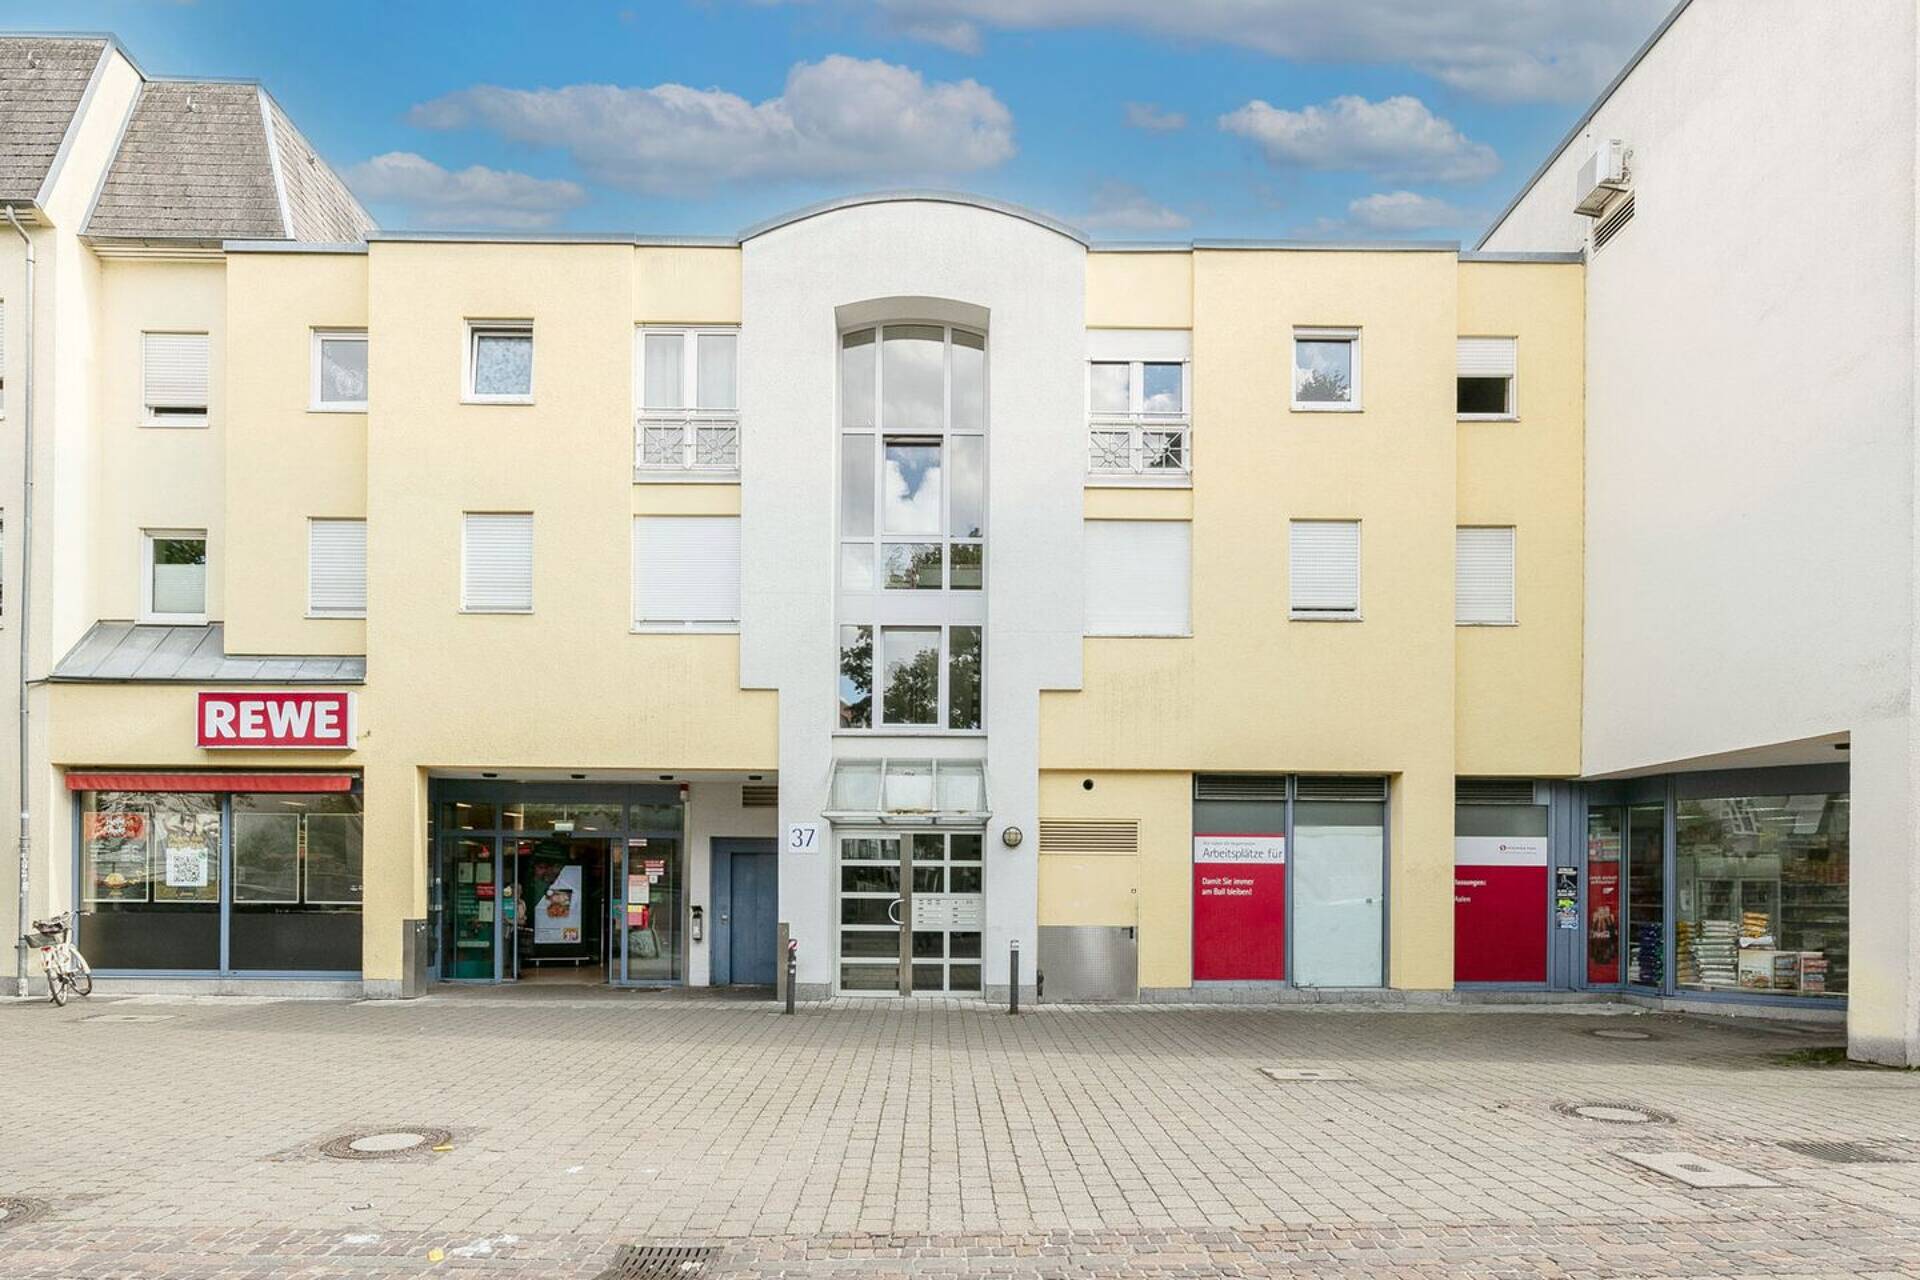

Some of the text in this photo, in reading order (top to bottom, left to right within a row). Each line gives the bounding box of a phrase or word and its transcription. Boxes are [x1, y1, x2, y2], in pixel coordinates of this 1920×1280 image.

[205, 701, 341, 738] REWE
[792, 828, 815, 847] 37
[1202, 847, 1283, 860] Arbeitsplätze für
